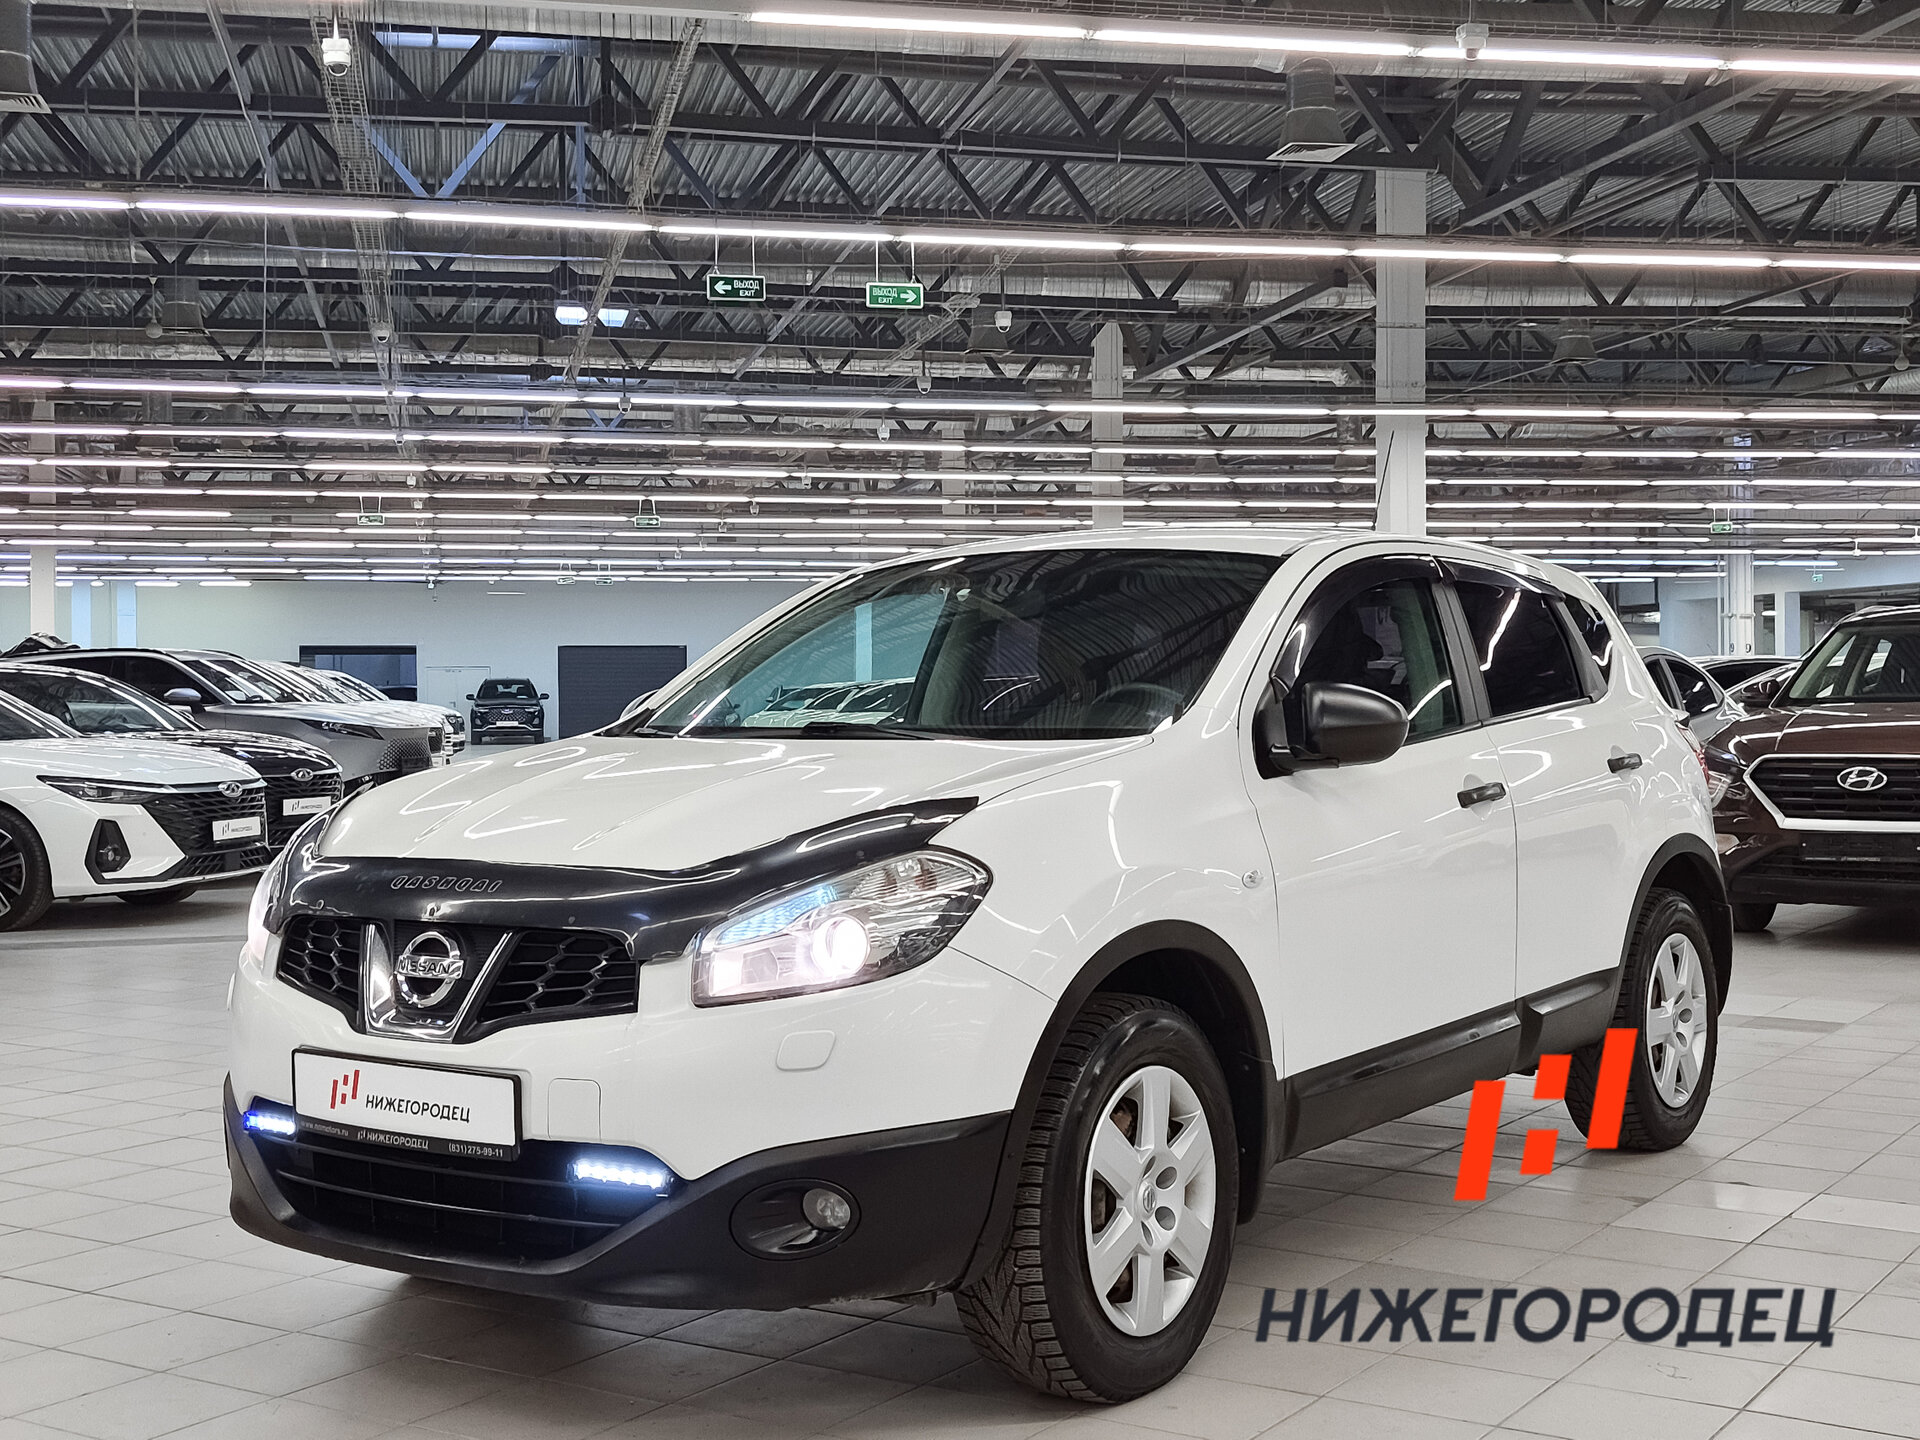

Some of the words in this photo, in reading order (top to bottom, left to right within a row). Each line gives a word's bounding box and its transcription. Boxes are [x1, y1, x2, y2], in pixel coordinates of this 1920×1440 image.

[733, 279, 760, 290] ВЫХОД
[739, 289, 756, 297] EXIT
[872, 287, 898, 298] ВЫХОД
[878, 296, 894, 304] EXIT
[390, 875, 503, 893] QASHQAI
[398, 956, 451, 976] NISSAN
[365, 1094, 471, 1124] НИЖЕГОРОДЕЦ
[366, 1131, 429, 1150] НИЖЕГОРОДЕЦ
